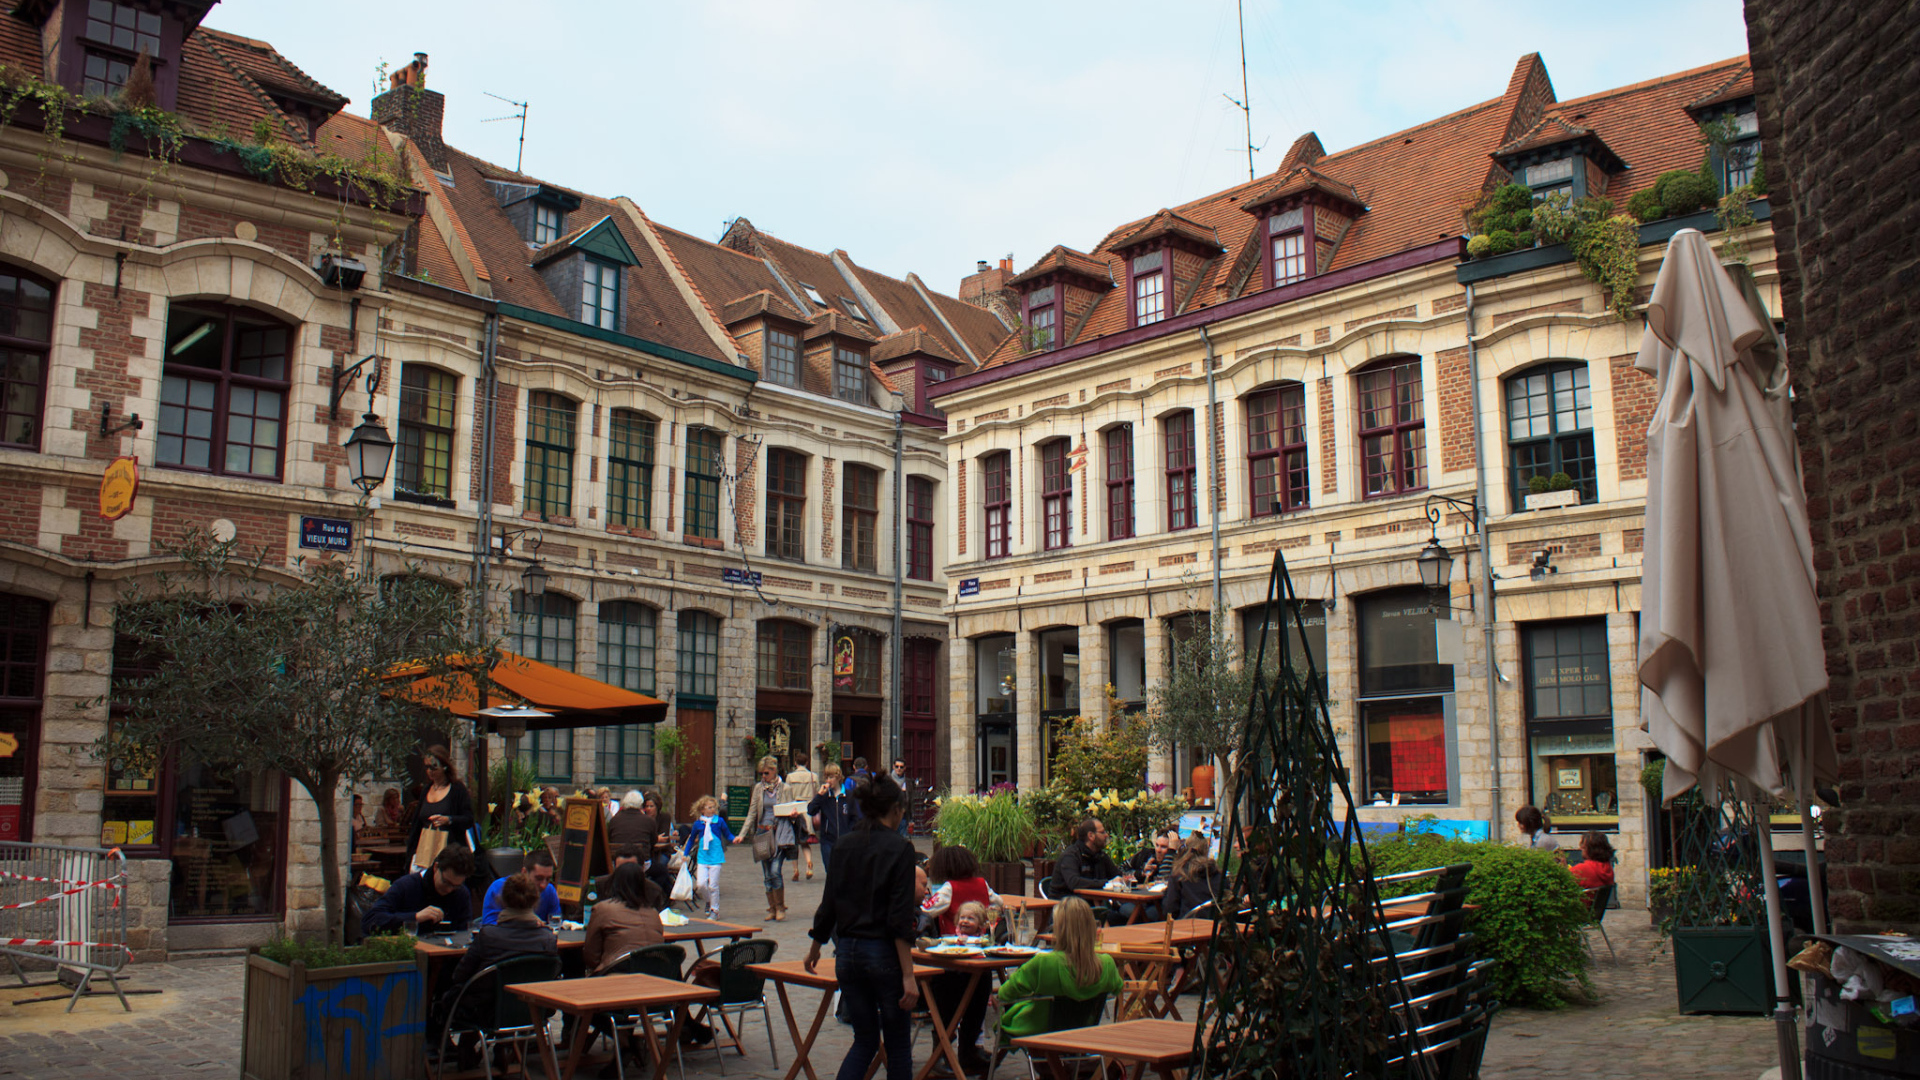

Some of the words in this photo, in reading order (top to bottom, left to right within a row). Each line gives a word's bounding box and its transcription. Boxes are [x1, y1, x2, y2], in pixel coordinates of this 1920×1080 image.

[323, 523, 335, 533] Rue
[337, 525, 349, 534] des
[306, 534, 327, 544] VIEUX
[328, 536, 347, 546] MURS
[1403, 606, 1441, 616] VELJKOIC
[1551, 667, 1589, 675] EXPERT
[1539, 674, 1600, 684] GEMMOLOGUE
